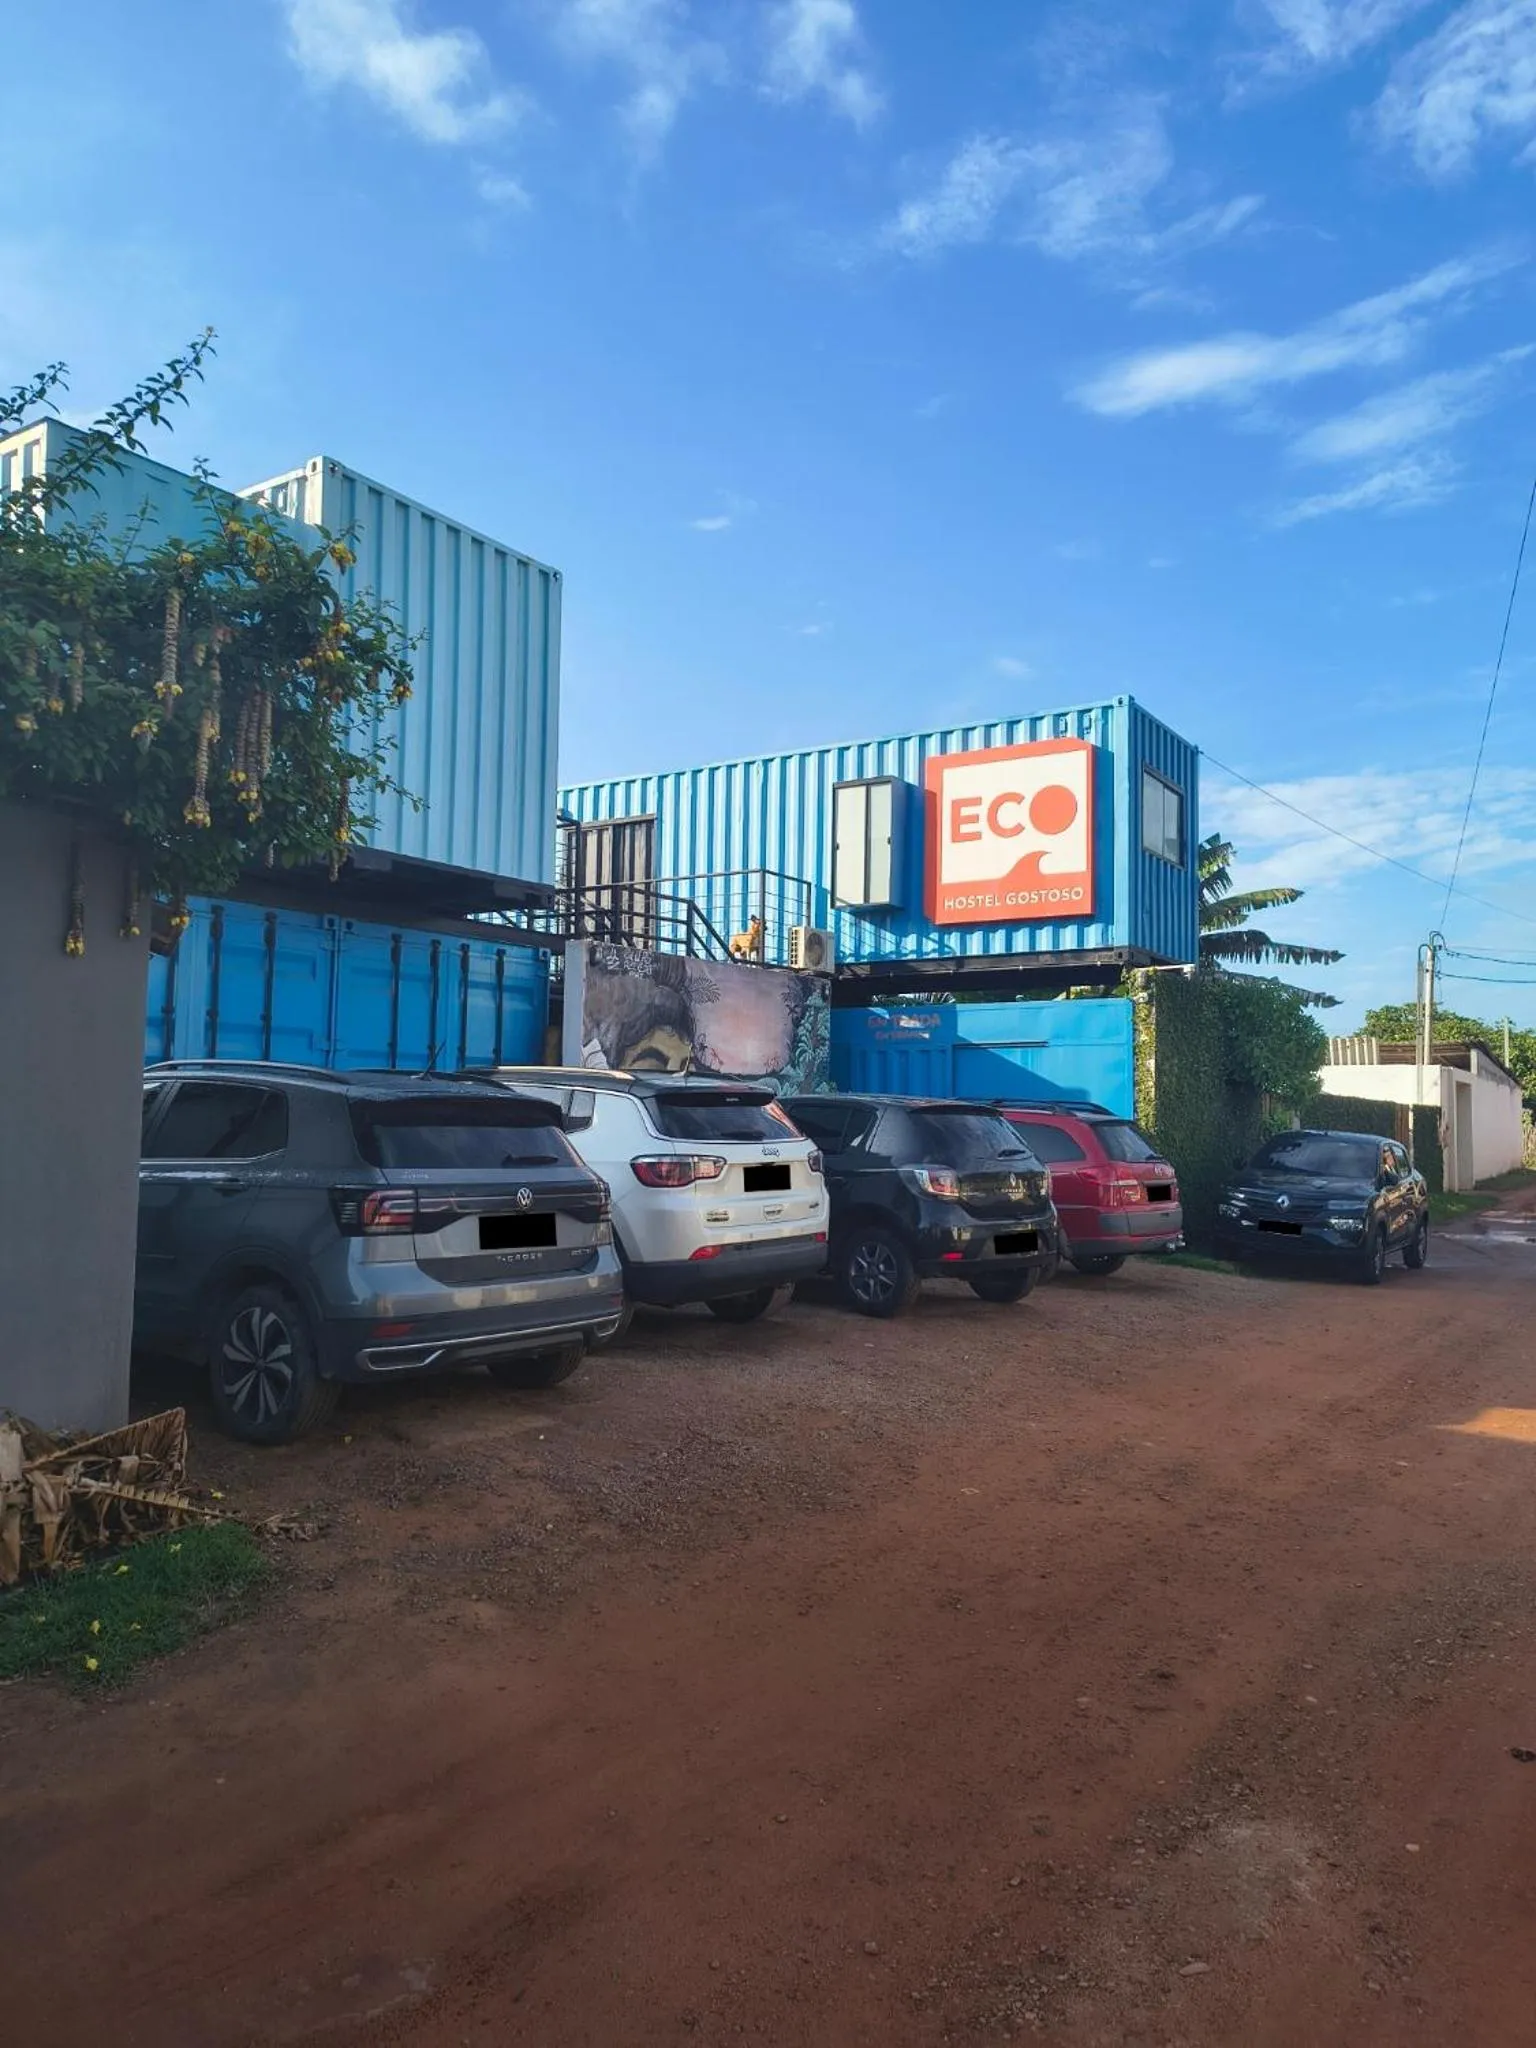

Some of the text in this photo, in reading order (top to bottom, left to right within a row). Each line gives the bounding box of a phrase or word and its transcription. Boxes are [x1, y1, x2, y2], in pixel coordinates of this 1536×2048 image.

[951, 784, 1078, 843] ECO
[944, 887, 1084, 910] HOSTEL GOSTOSO
